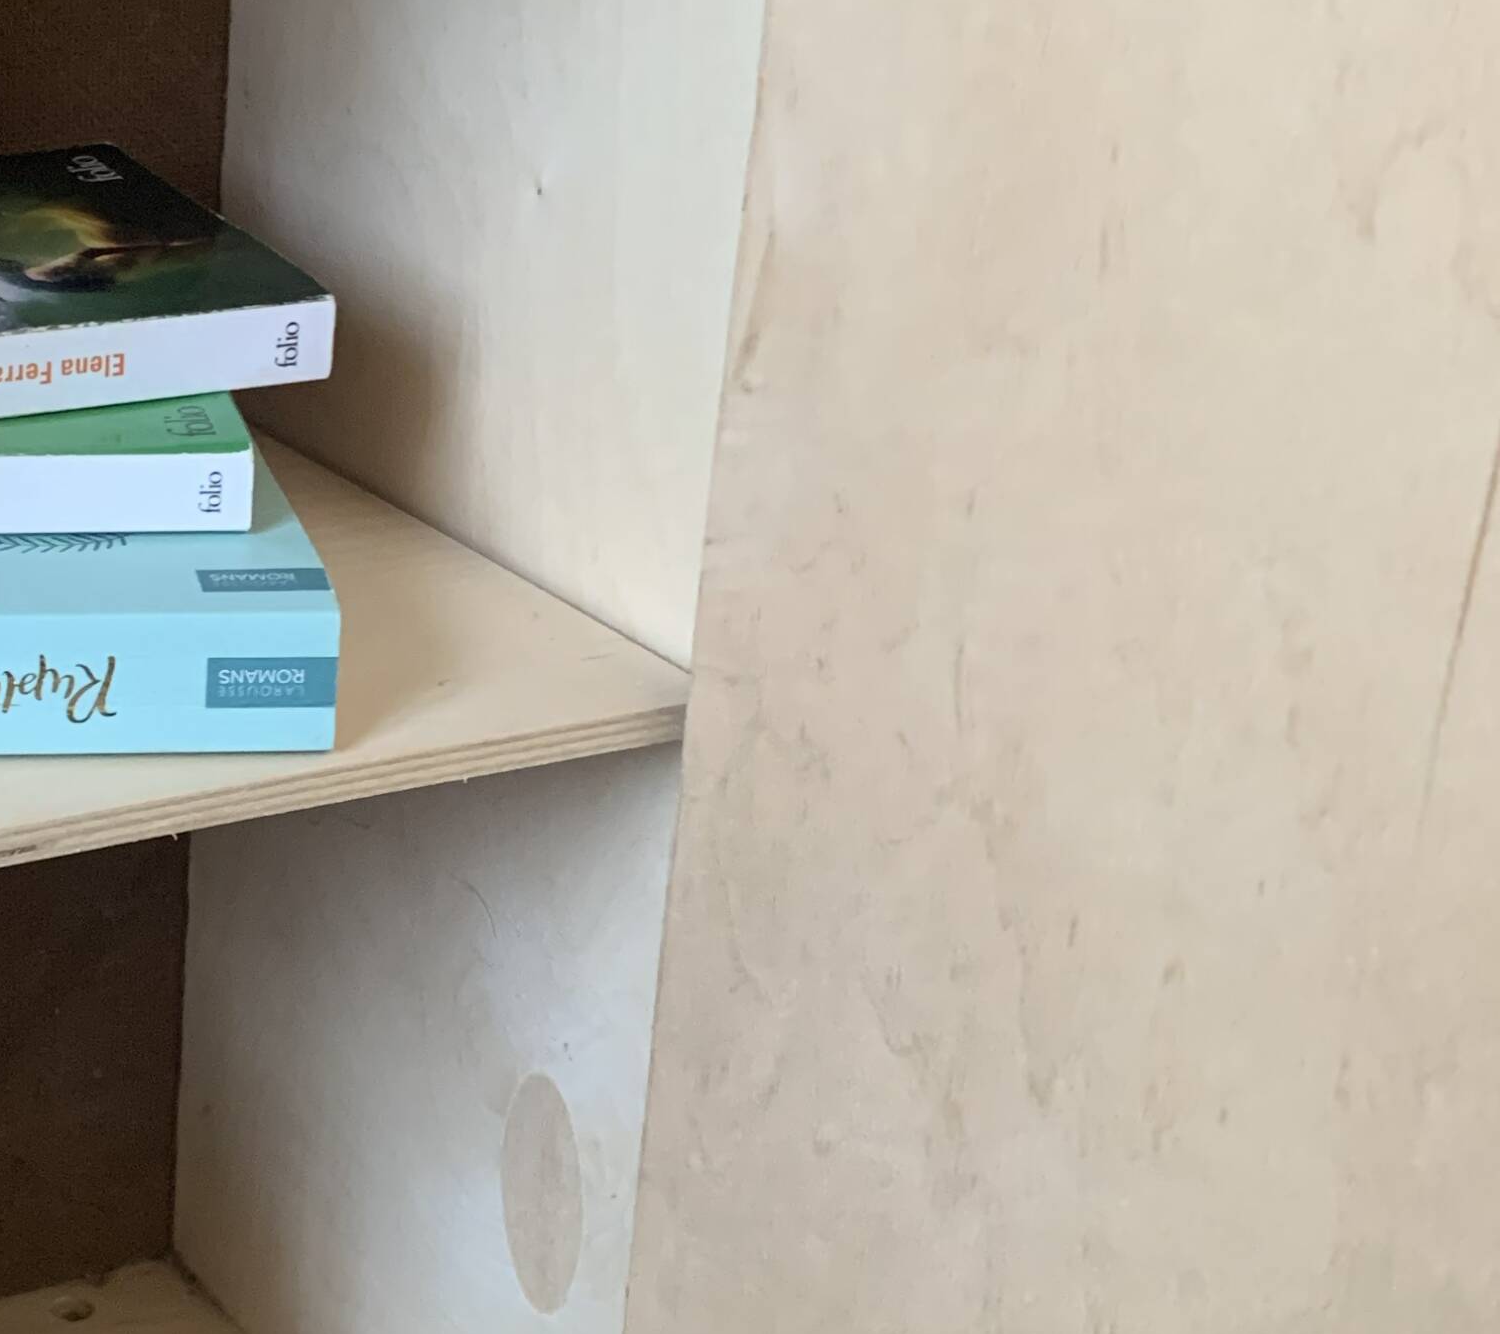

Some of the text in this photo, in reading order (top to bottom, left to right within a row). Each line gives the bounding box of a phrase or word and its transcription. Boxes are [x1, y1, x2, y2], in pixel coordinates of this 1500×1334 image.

[68, 155, 123, 183] folio
[274, 320, 300, 368] folio
[61, 353, 126, 378] Elena
[166, 404, 217, 438] folio
[197, 470, 224, 514] folio
[218, 669, 305, 684] ROMANS
[218, 685, 304, 698] LAROUSSE
